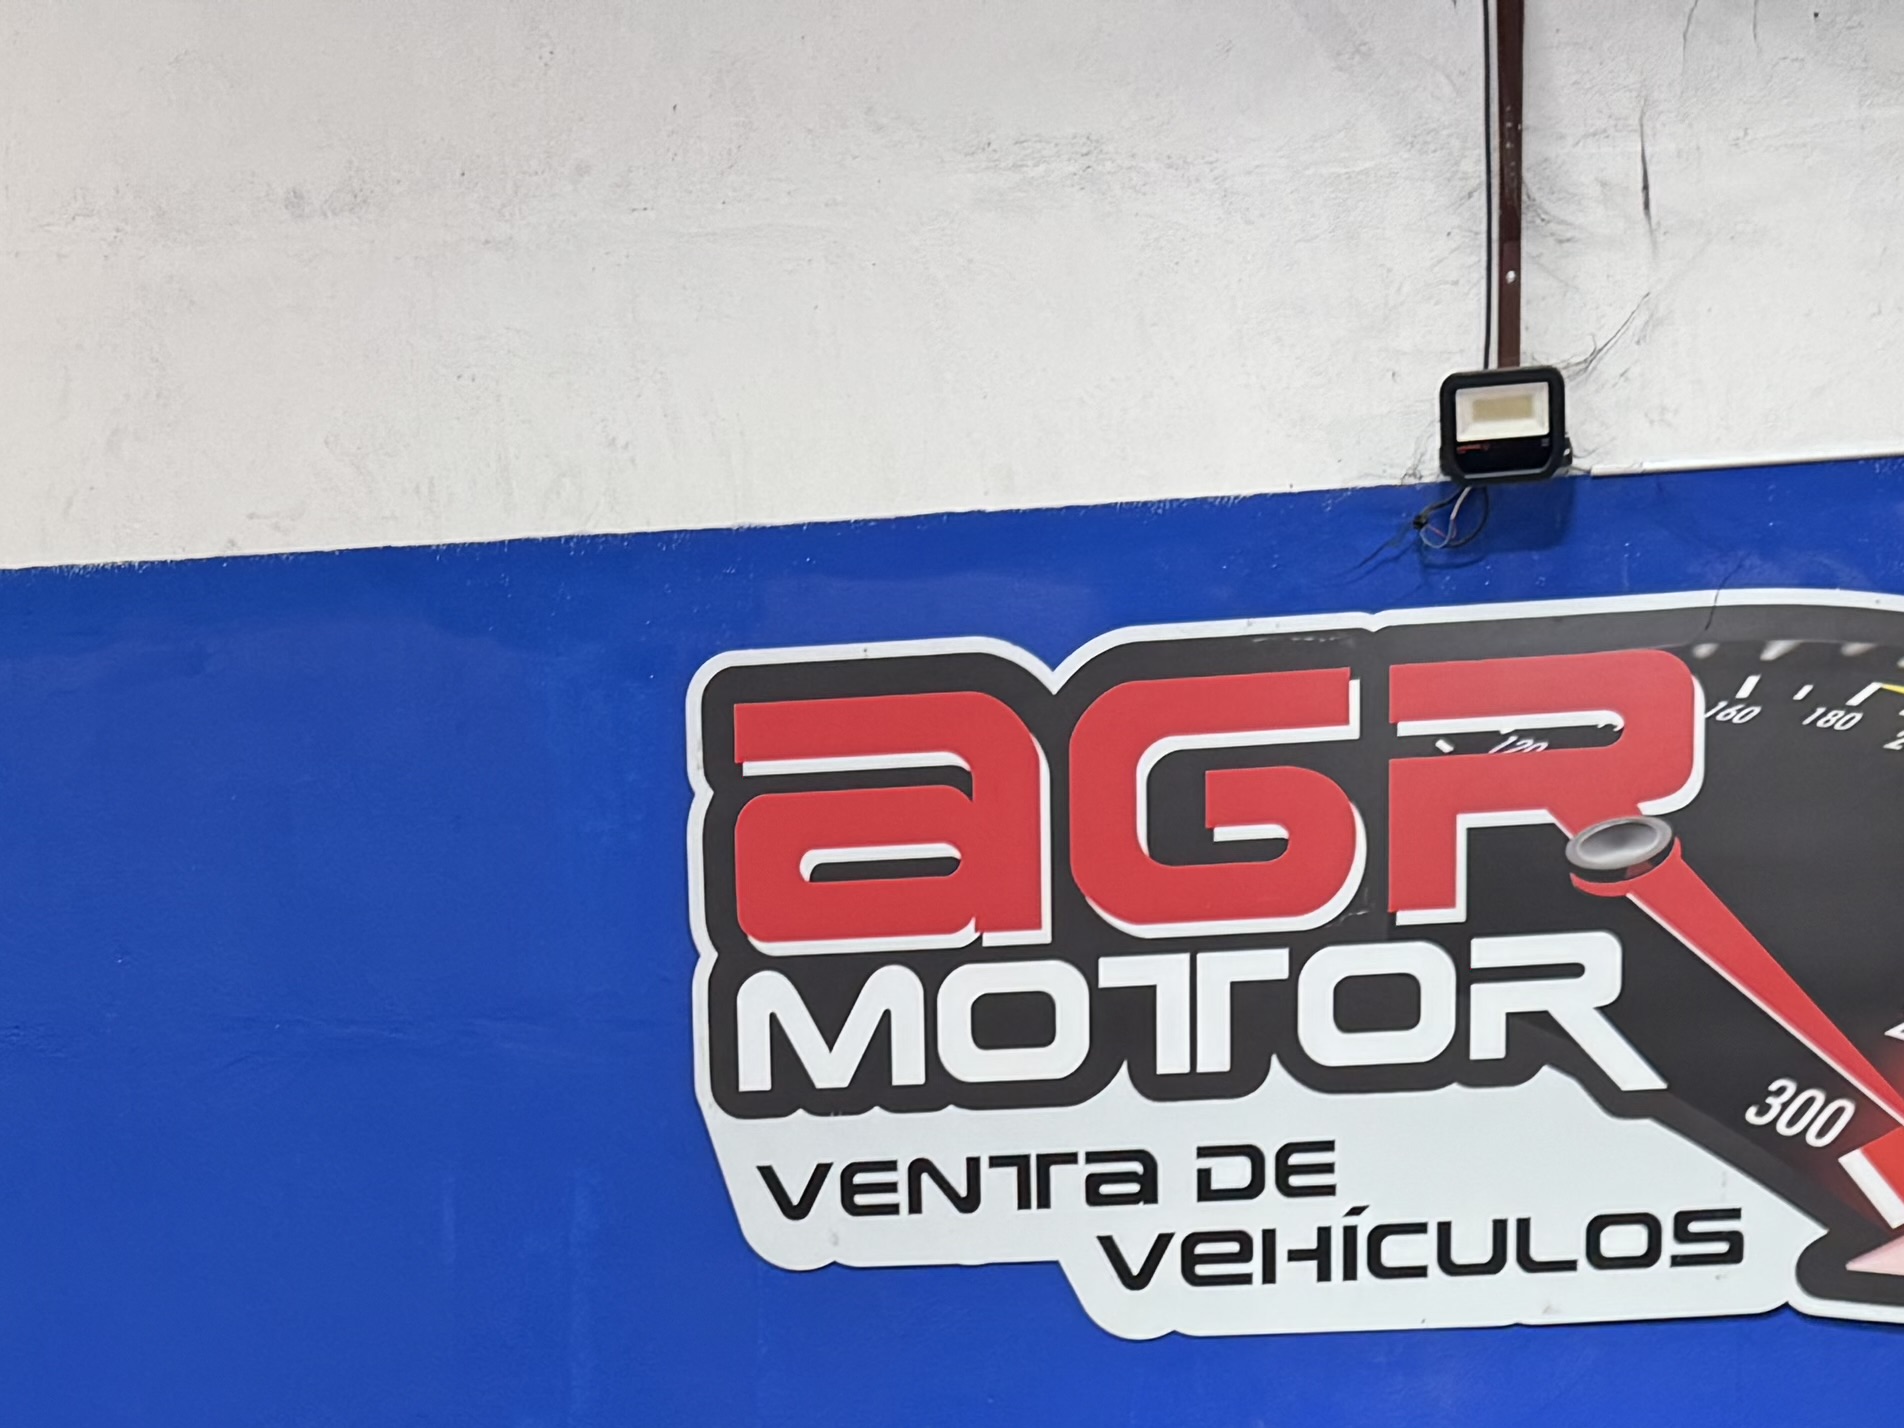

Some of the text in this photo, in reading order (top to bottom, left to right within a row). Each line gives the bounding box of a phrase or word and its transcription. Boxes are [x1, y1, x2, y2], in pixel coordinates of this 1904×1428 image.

[1704, 700, 1763, 724] 160
[1802, 706, 1863, 731] 180
[737, 929, 1668, 1092] MOTOR
[1744, 1077, 1856, 1148] 300
[1195, 1139, 1337, 1200] DE
